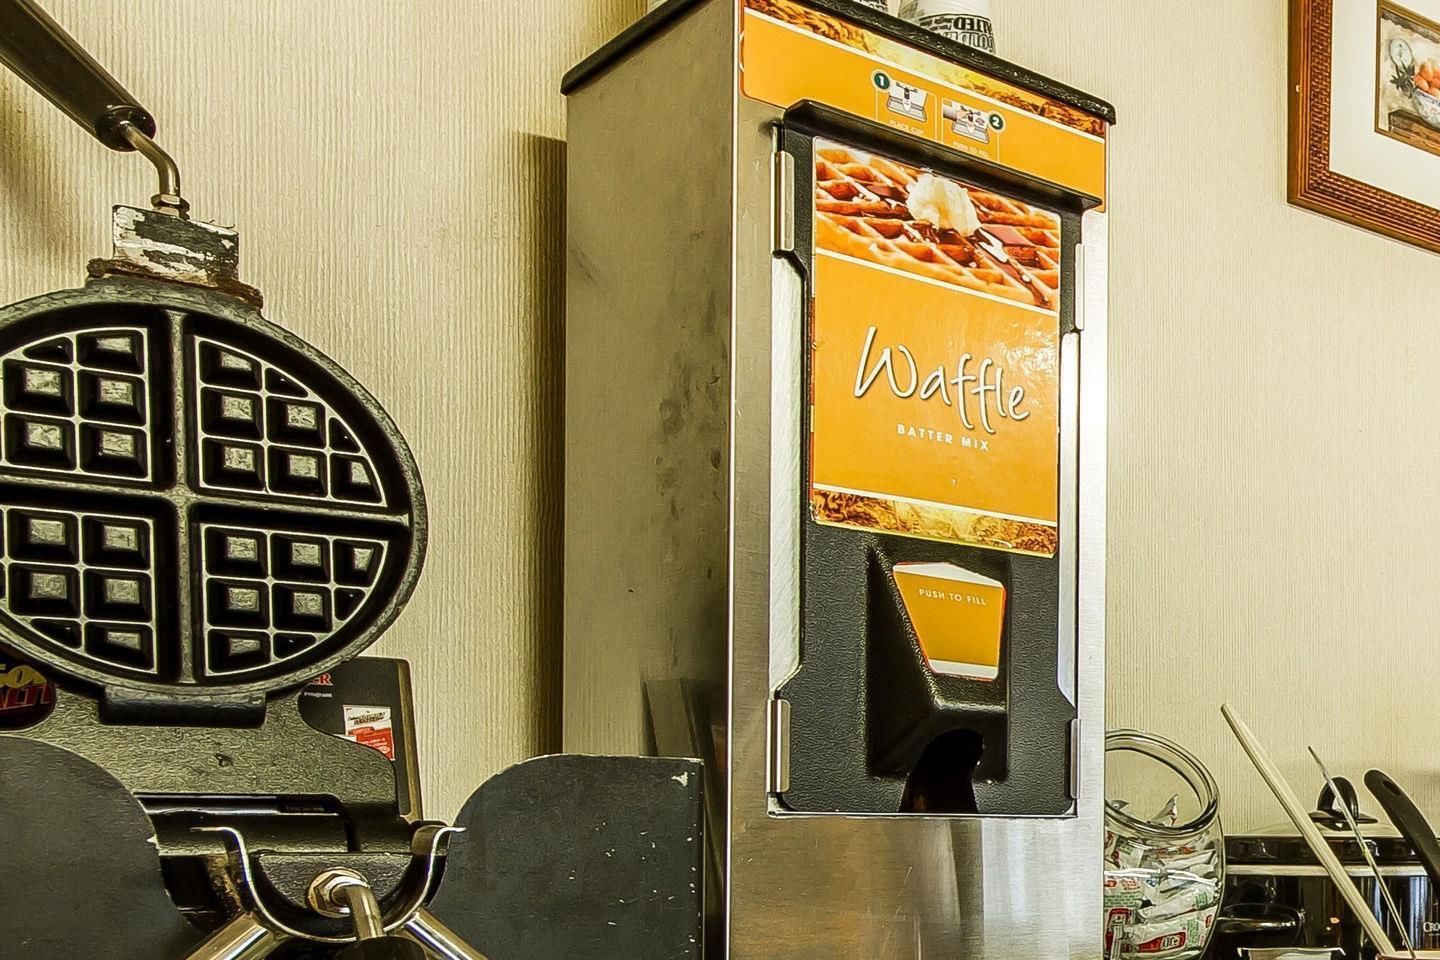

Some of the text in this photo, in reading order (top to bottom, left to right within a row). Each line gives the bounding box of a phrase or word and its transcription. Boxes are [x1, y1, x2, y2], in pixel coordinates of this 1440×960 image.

[854, 325, 1031, 434] Waffle
[897, 423, 989, 451] BATTER MIX
[918, 588, 987, 606] PUSH TO FILL
